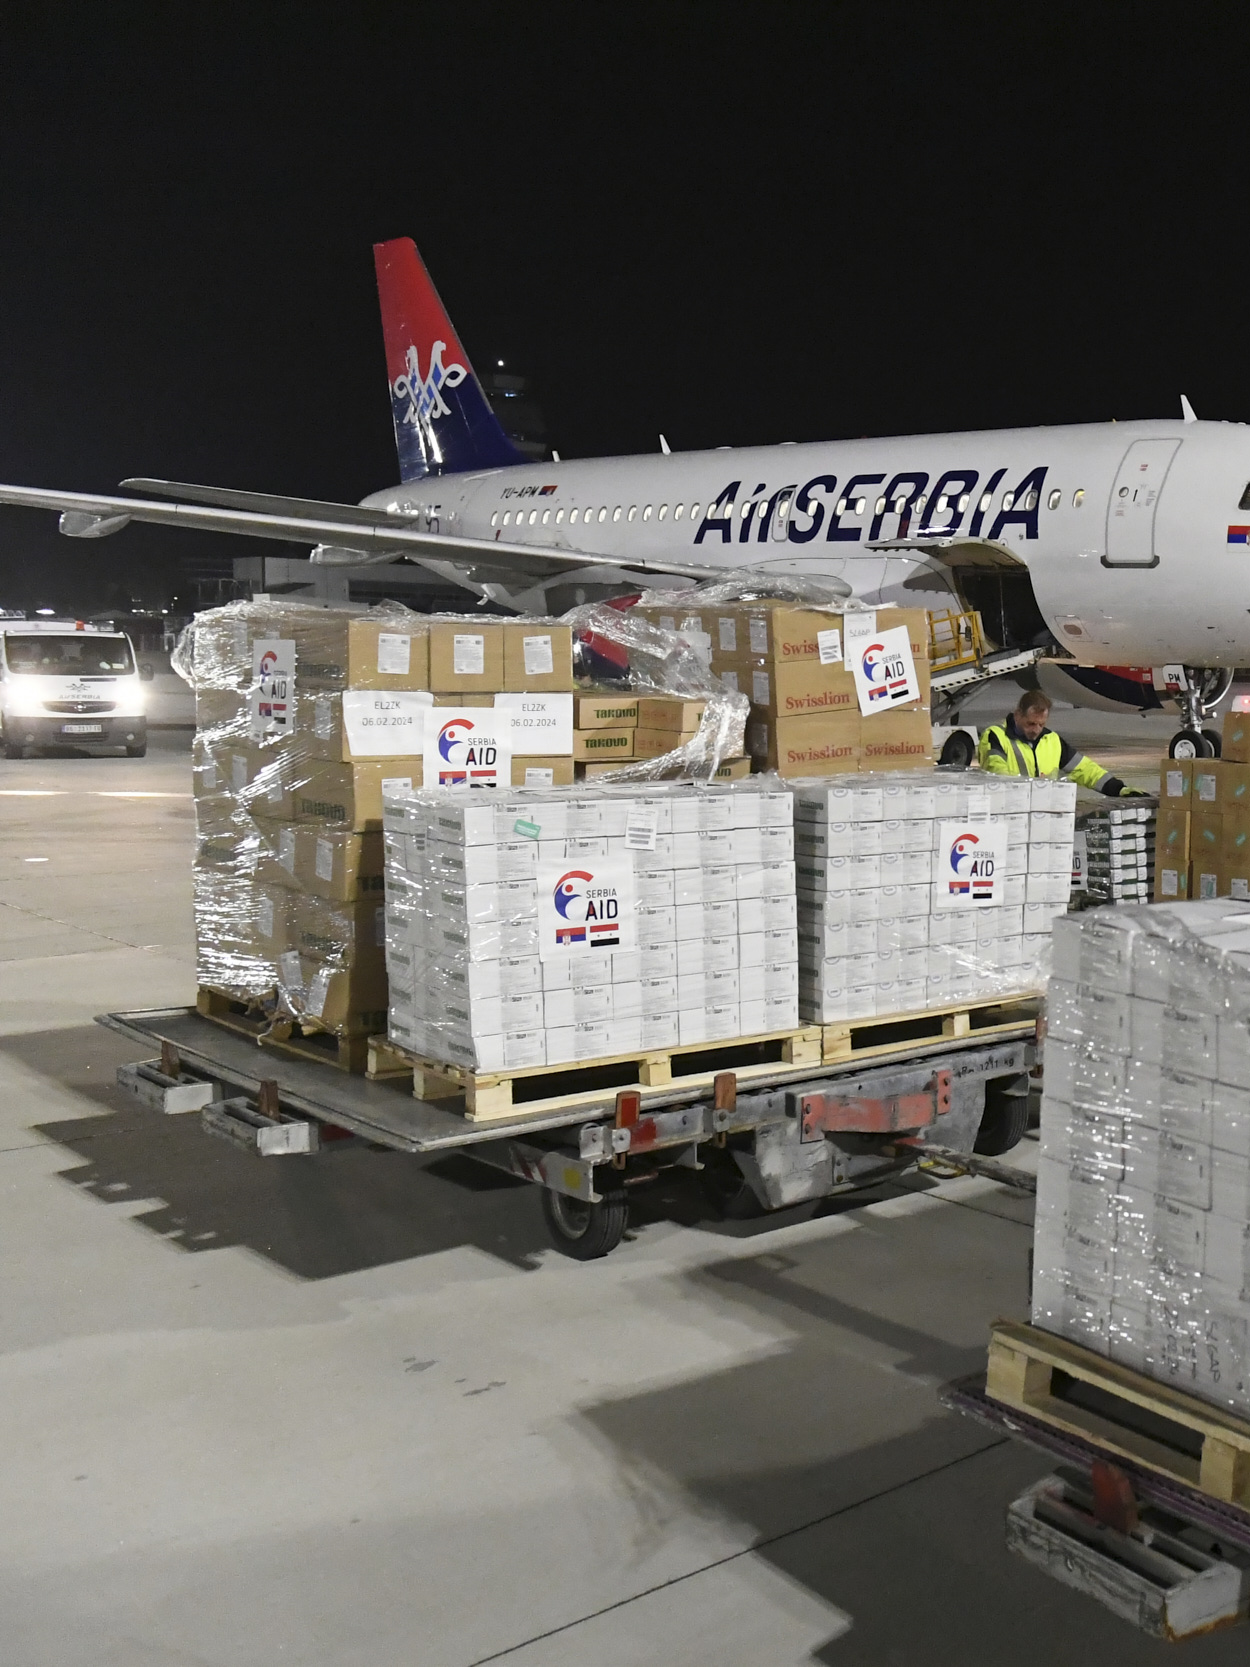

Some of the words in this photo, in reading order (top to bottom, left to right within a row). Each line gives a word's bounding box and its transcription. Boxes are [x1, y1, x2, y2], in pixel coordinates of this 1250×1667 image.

[500, 486, 539, 499] YU-APM
[782, 639, 819, 656] Swiss
[882, 653, 902, 665] SERBIA
[884, 661, 905, 681] AID
[1168, 673, 1182, 683] PM
[271, 680, 287, 699] AID
[785, 691, 850, 710] Swisslion
[362, 716, 413, 727] 06.02.2024
[467, 737, 497, 746] SERBIA
[865, 741, 925, 757] Swisslion
[465, 747, 497, 766] AID
[787, 745, 853, 764] Swisslion
[972, 850, 995, 859] SERBIA
[970, 860, 995, 877] AID
[585, 887, 618, 899] SERBIA
[585, 899, 619, 921] AID
